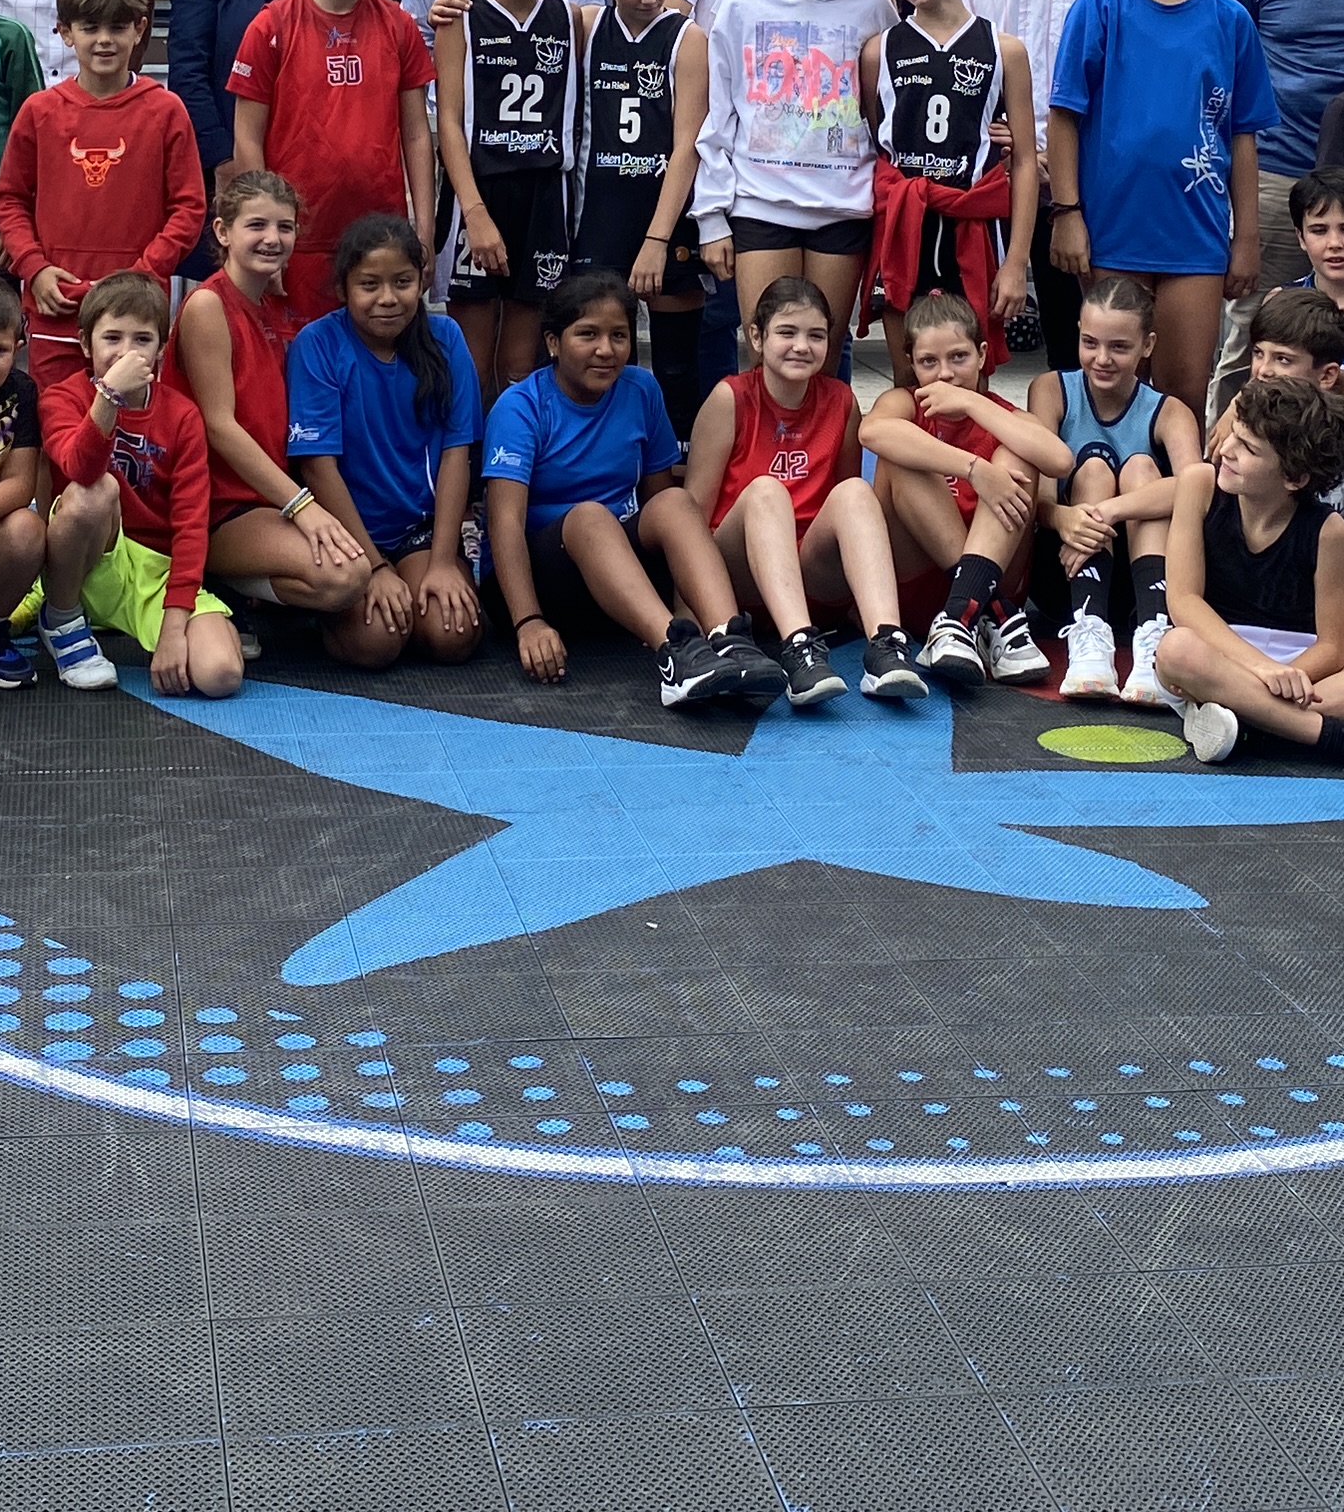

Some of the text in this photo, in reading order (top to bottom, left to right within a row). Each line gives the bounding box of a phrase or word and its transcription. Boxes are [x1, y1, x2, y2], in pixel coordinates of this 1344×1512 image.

[326, 55, 363, 87] 50
[487, 56, 518, 67] La Rioja
[499, 73, 545, 123] 22
[619, 97, 641, 144] 5
[925, 94, 950, 144] 8
[479, 129, 545, 143] Helen Doron
[507, 141, 542, 154] English
[596, 152, 656, 166] Helen Doron
[925, 153, 958, 168] Doron
[769, 451, 809, 481] 42
